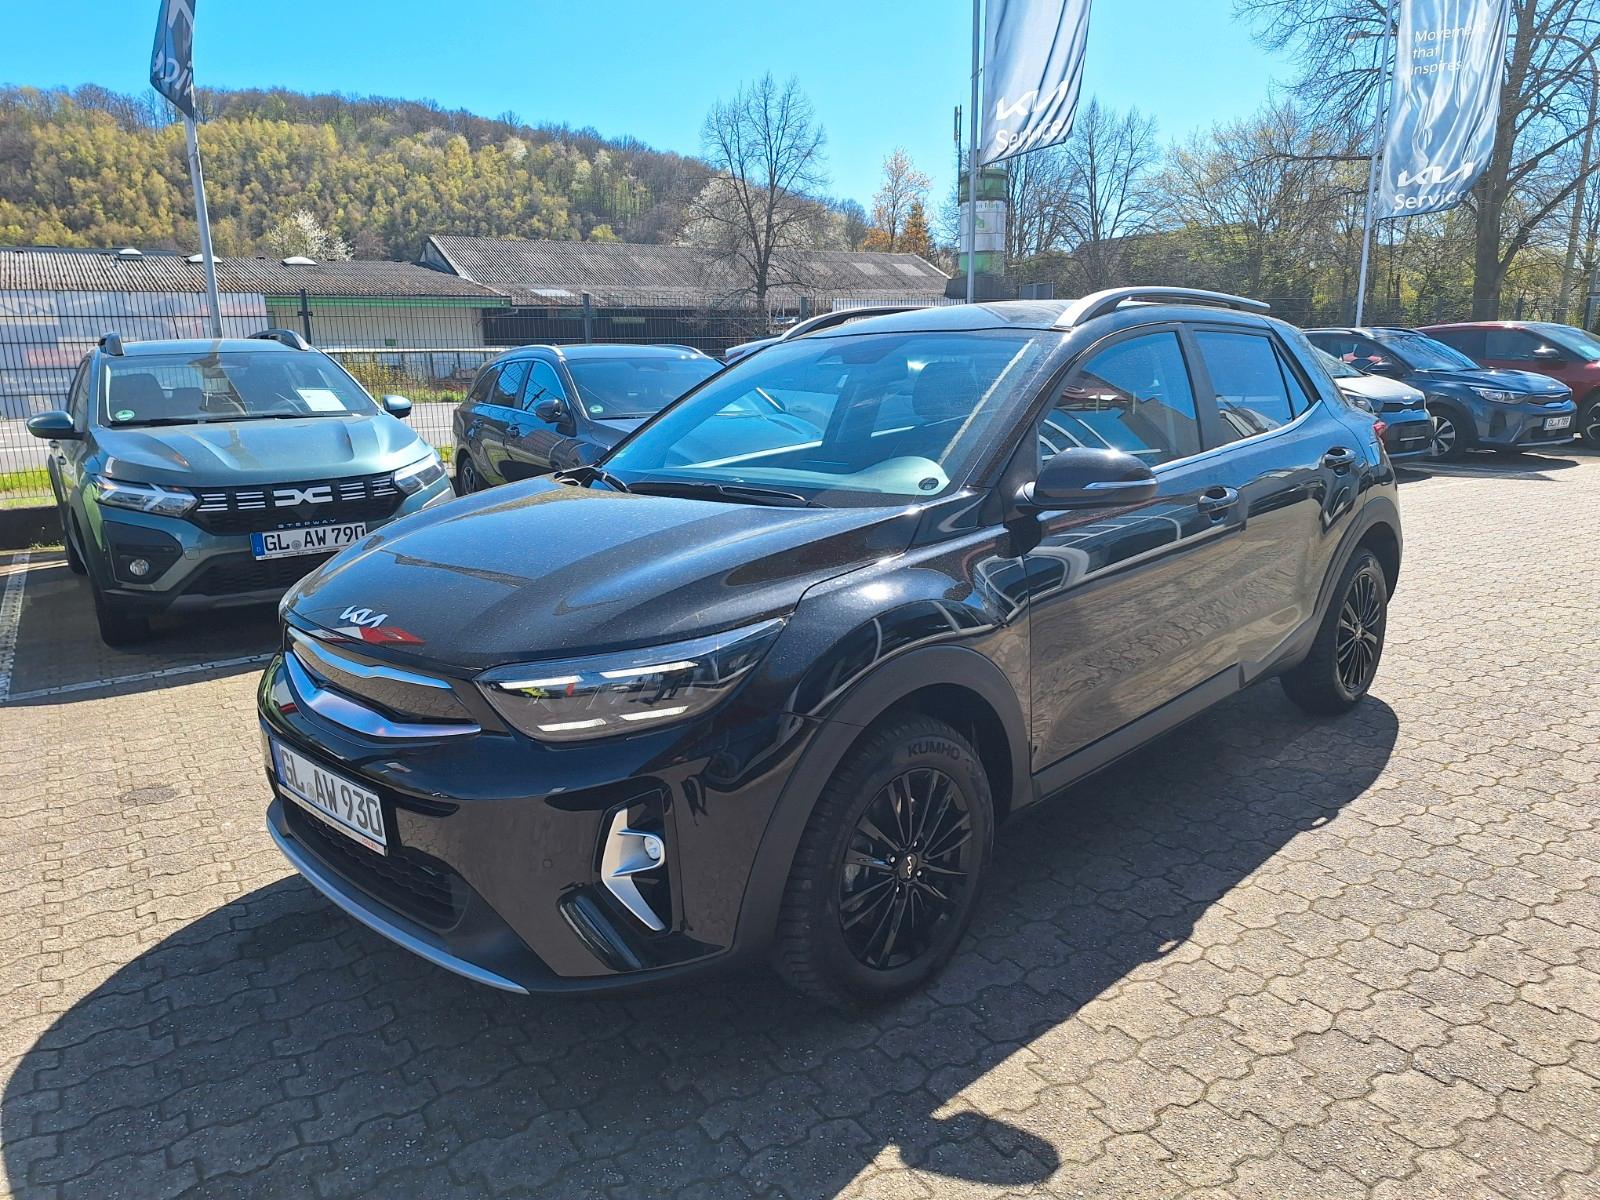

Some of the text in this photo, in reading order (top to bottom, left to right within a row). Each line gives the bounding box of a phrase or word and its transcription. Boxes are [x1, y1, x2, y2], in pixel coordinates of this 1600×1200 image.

[1412, 45, 1440, 60] that
[1409, 60, 1462, 76] inspires
[277, 518, 337, 529] STEPWAY
[263, 533, 290, 552] GL
[304, 528, 327, 548] AW
[331, 525, 366, 545] 790
[907, 741, 961, 761] KUMHO
[281, 749, 306, 795] GL
[314, 768, 338, 814] AW
[340, 784, 383, 838] 930
